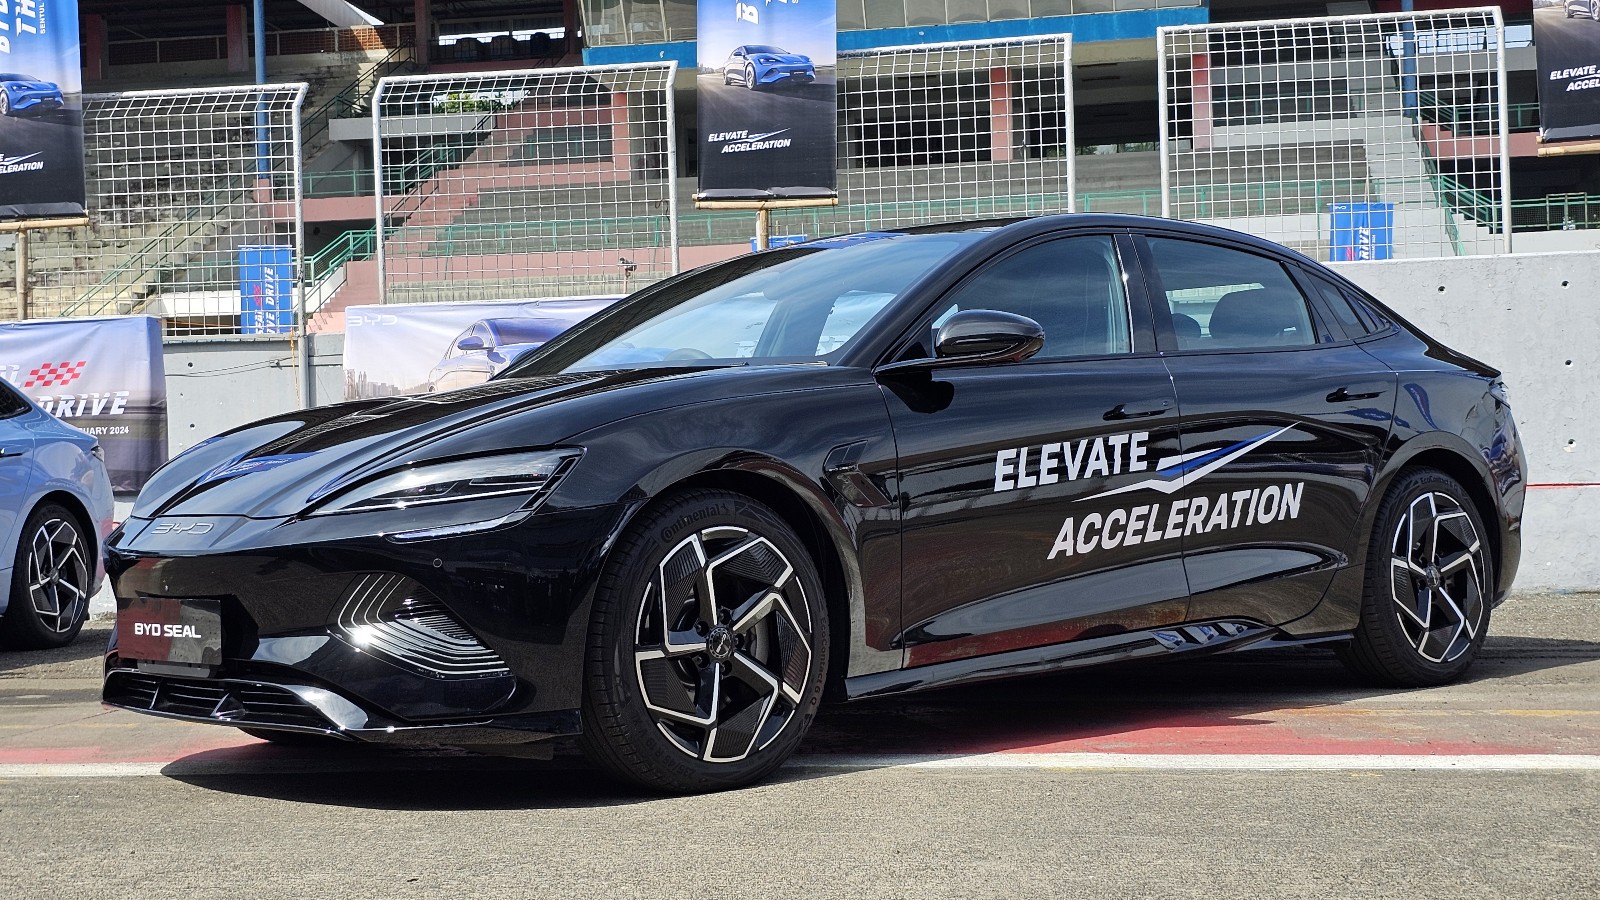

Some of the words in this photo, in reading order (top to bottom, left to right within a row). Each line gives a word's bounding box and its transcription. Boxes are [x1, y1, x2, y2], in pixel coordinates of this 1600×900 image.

[38, 2, 46, 35] SENTUL
[1550, 65, 1597, 80] ELEVATE
[708, 130, 749, 142] ELEVATE
[721, 138, 791, 154] ACCELERATION
[1358, 226, 1370, 260] RIVE
[264, 266, 275, 305] DRIVE
[347, 314, 398, 327] BYD
[35, 390, 130, 418] DRIVE
[79, 426, 108, 436] UARY
[109, 425, 130, 435] 2024
[994, 432, 1149, 492] ELEVATE
[151, 522, 215, 534] BYD
[661, 503, 720, 543] Continental
[1046, 482, 1304, 560] ACCELERATION
[134, 622, 161, 637] BYD
[163, 623, 202, 639] SEAL
[817, 618, 828, 683] EcoContact
[810, 697, 817, 706] Q
